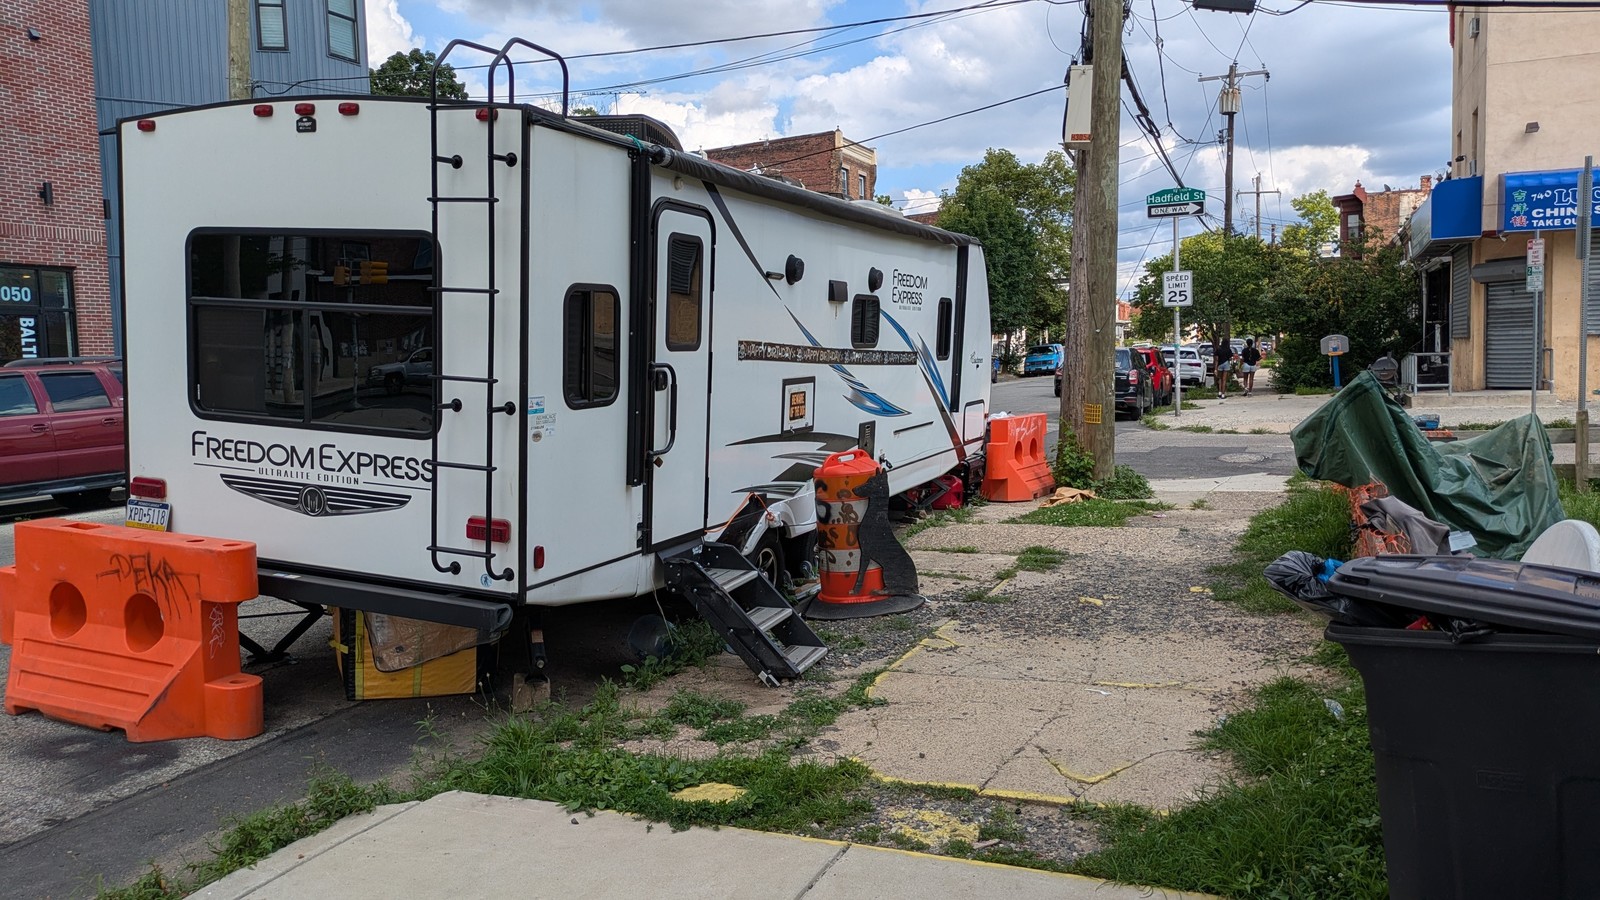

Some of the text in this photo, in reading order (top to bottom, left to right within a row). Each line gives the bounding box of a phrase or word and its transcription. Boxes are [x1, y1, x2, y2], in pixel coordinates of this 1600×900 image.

[1147, 191, 1204, 204] Hadfield St
[1531, 190, 1552, 201] 740
[1532, 218, 1578, 227] TAKE OU
[893, 269, 928, 290] FREEDOM
[0, 286, 31, 302] 050
[892, 286, 923, 305] EXPRESS
[1168, 290, 1188, 303] 25
[20, 318, 37, 358] BALTI
[747, 343, 767, 358] HAPPY
[803, 348, 819, 361] HAPPY
[192, 431, 433, 482] FREEDOM EXPRESS
[258, 467, 359, 485] ULTRALITE EDITION
